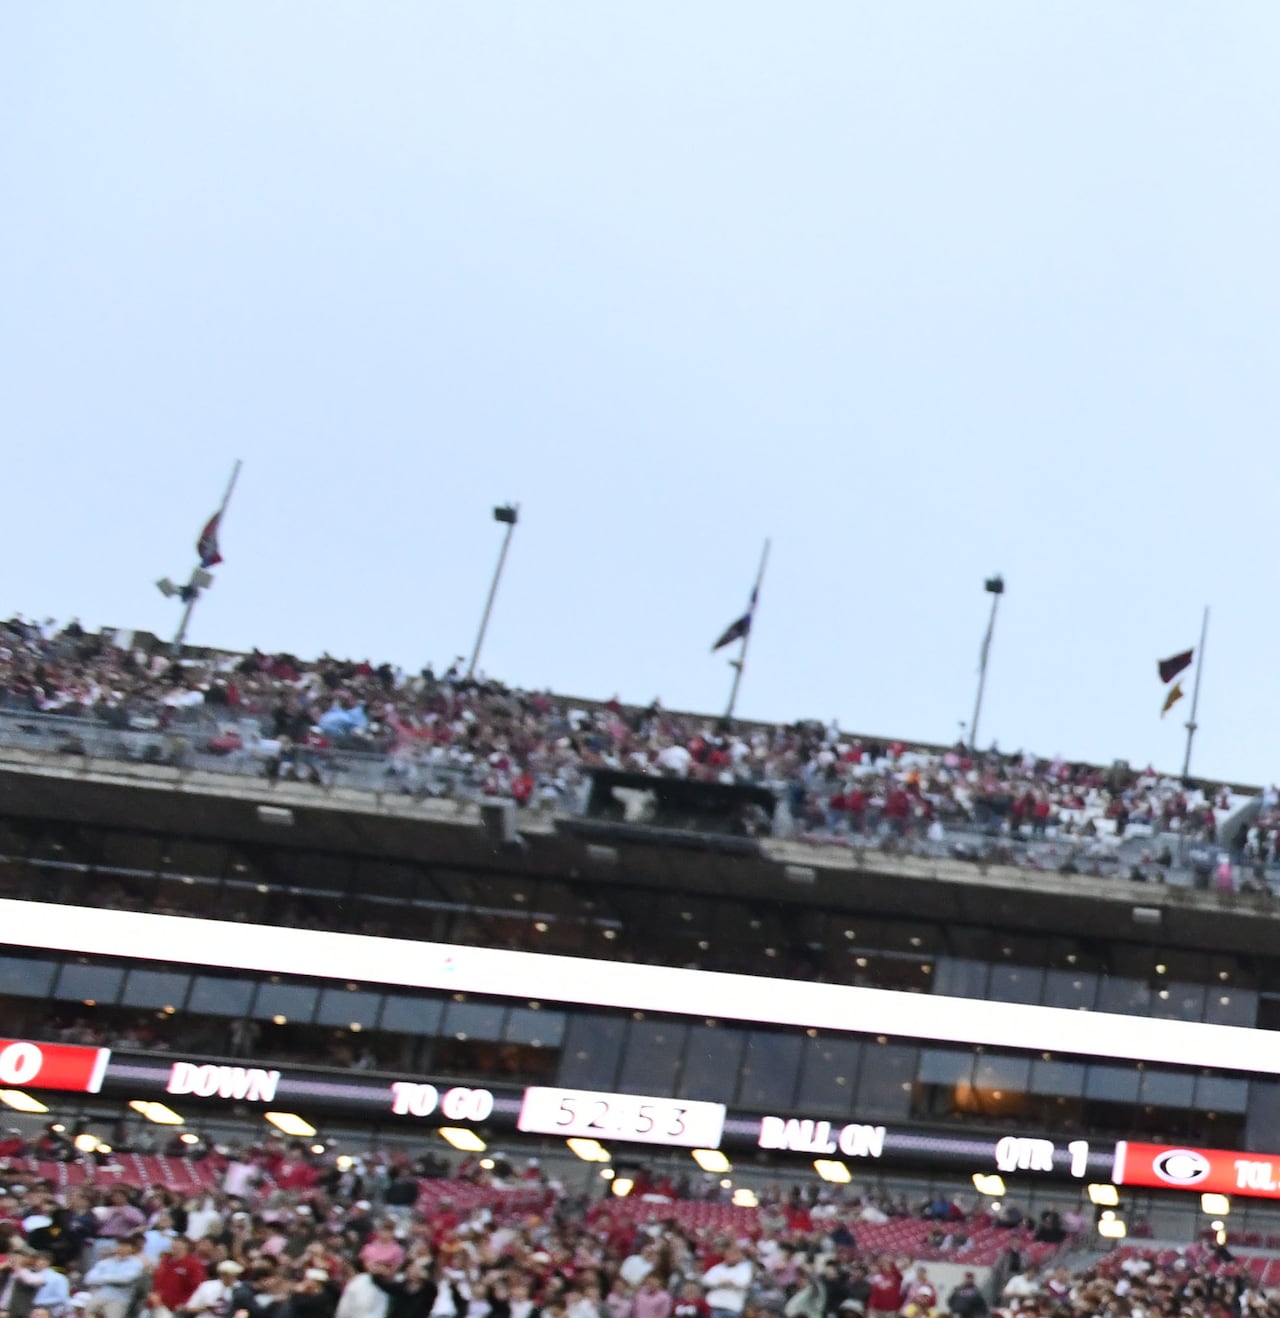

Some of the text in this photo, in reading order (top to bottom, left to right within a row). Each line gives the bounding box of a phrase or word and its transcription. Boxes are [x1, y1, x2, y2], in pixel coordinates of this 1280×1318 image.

[0, 1042, 42, 1084] 0
[167, 1061, 280, 1102] DOWN
[391, 1082, 493, 1121] TO GO
[758, 1116, 886, 1158] BALL ON
[995, 1136, 1088, 1177] QTR 1
